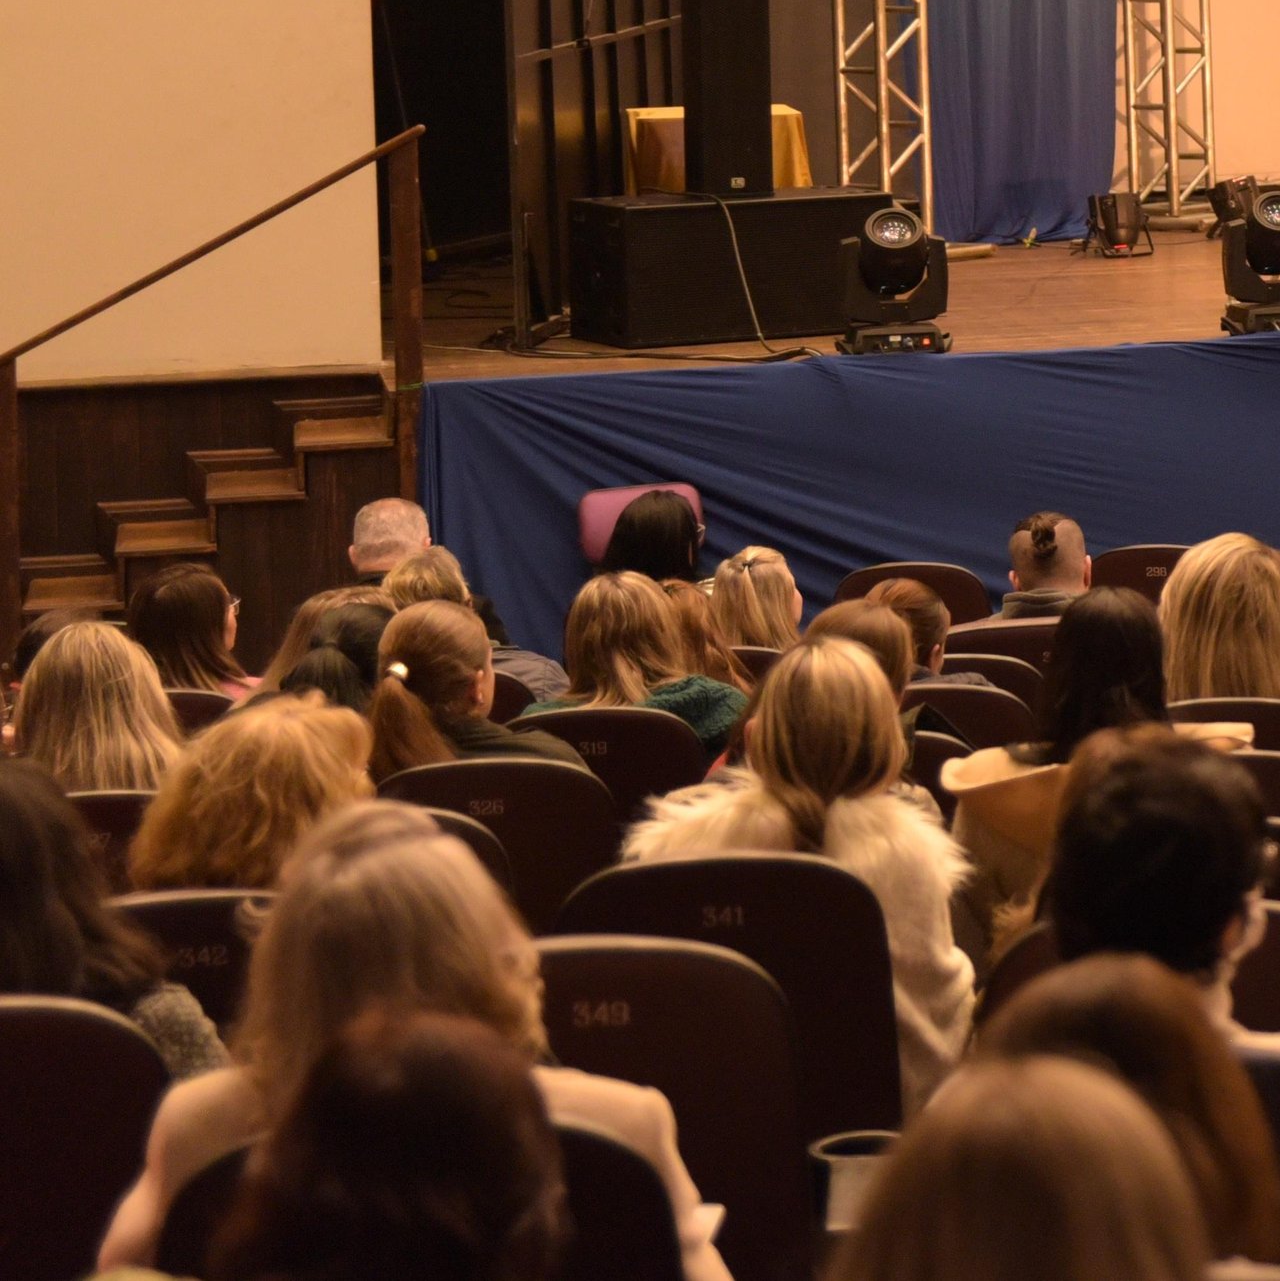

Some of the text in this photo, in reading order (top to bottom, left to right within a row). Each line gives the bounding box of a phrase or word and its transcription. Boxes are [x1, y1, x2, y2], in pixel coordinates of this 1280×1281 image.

[1145, 566, 1167, 578] 298
[579, 741, 608, 756] 319
[469, 798, 505, 816] 326
[702, 906, 745, 929] 341
[178, 944, 229, 970] 342
